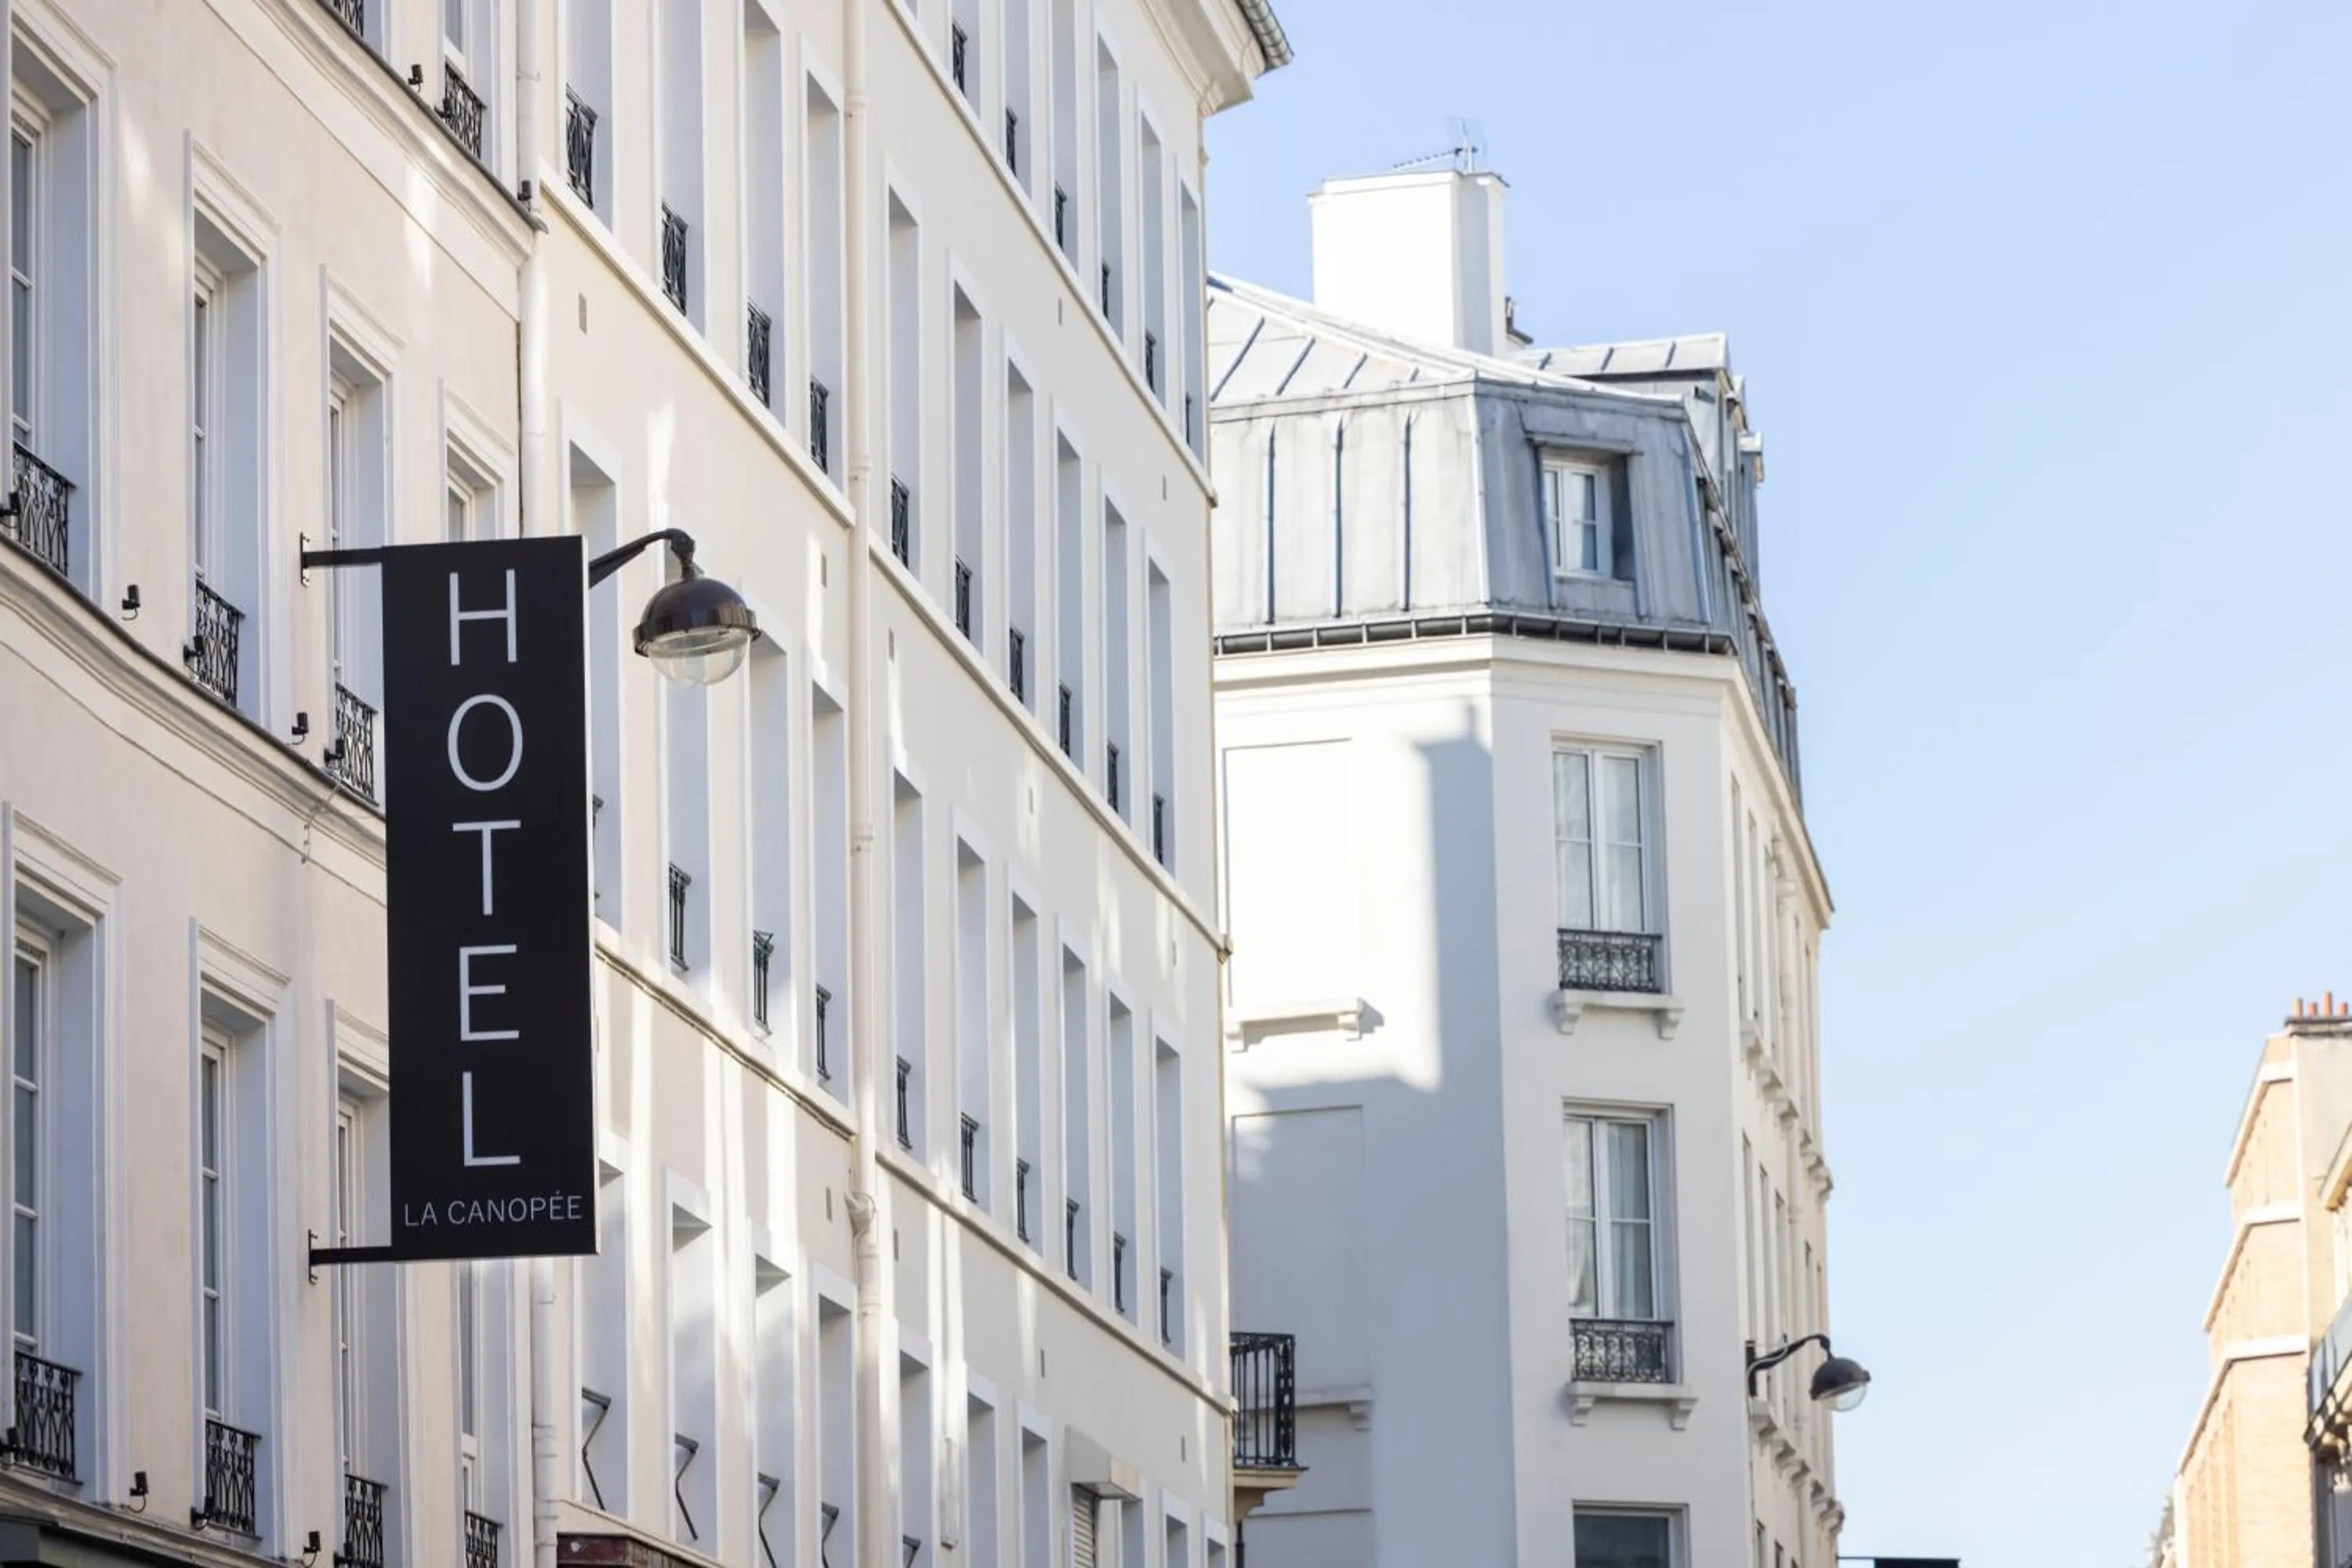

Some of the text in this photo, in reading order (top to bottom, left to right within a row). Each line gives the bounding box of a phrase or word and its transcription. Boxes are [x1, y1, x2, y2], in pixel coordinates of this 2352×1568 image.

[448, 568, 523, 1167] HOTEL
[405, 1189, 583, 1227] LA CANOPÉE
